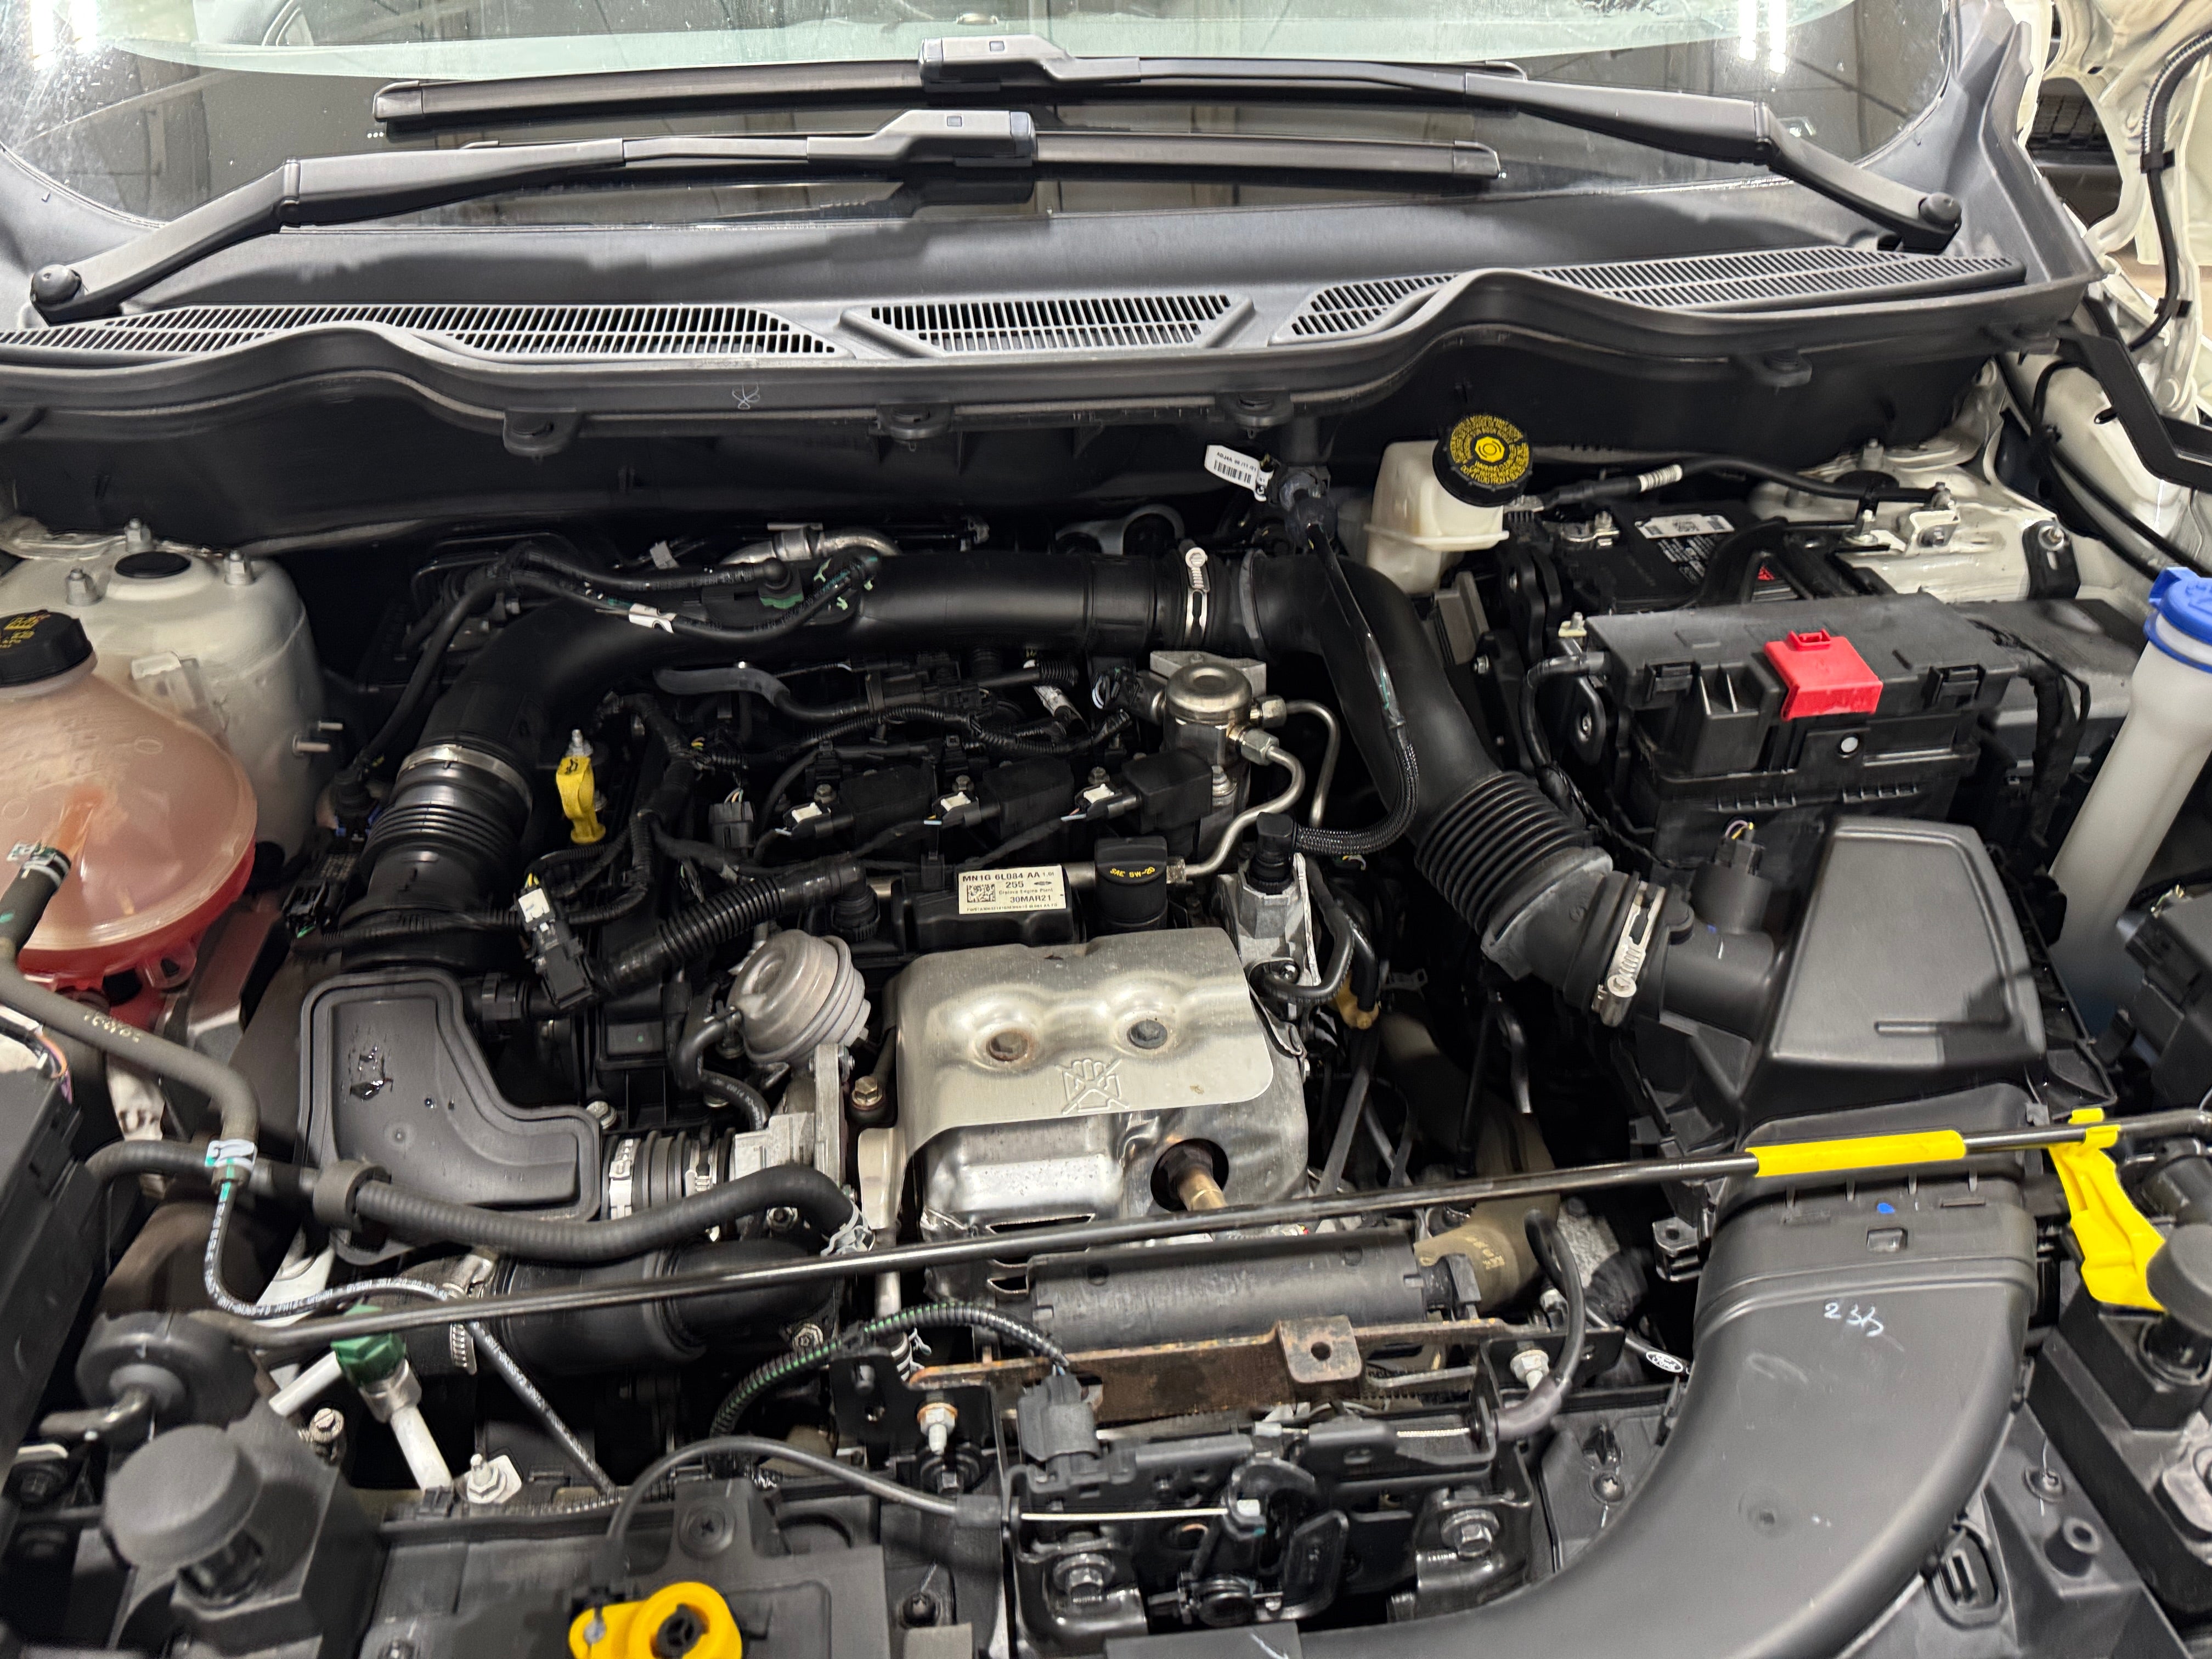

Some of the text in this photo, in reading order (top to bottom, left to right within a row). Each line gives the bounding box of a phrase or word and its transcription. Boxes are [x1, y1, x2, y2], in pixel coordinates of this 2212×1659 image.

[995, 872, 1024, 881] 6L084
[1110, 868, 1125, 877] SAE
[1010, 894, 1052, 904] 30MAR21
[1649, 1353, 1679, 1371] Ford
